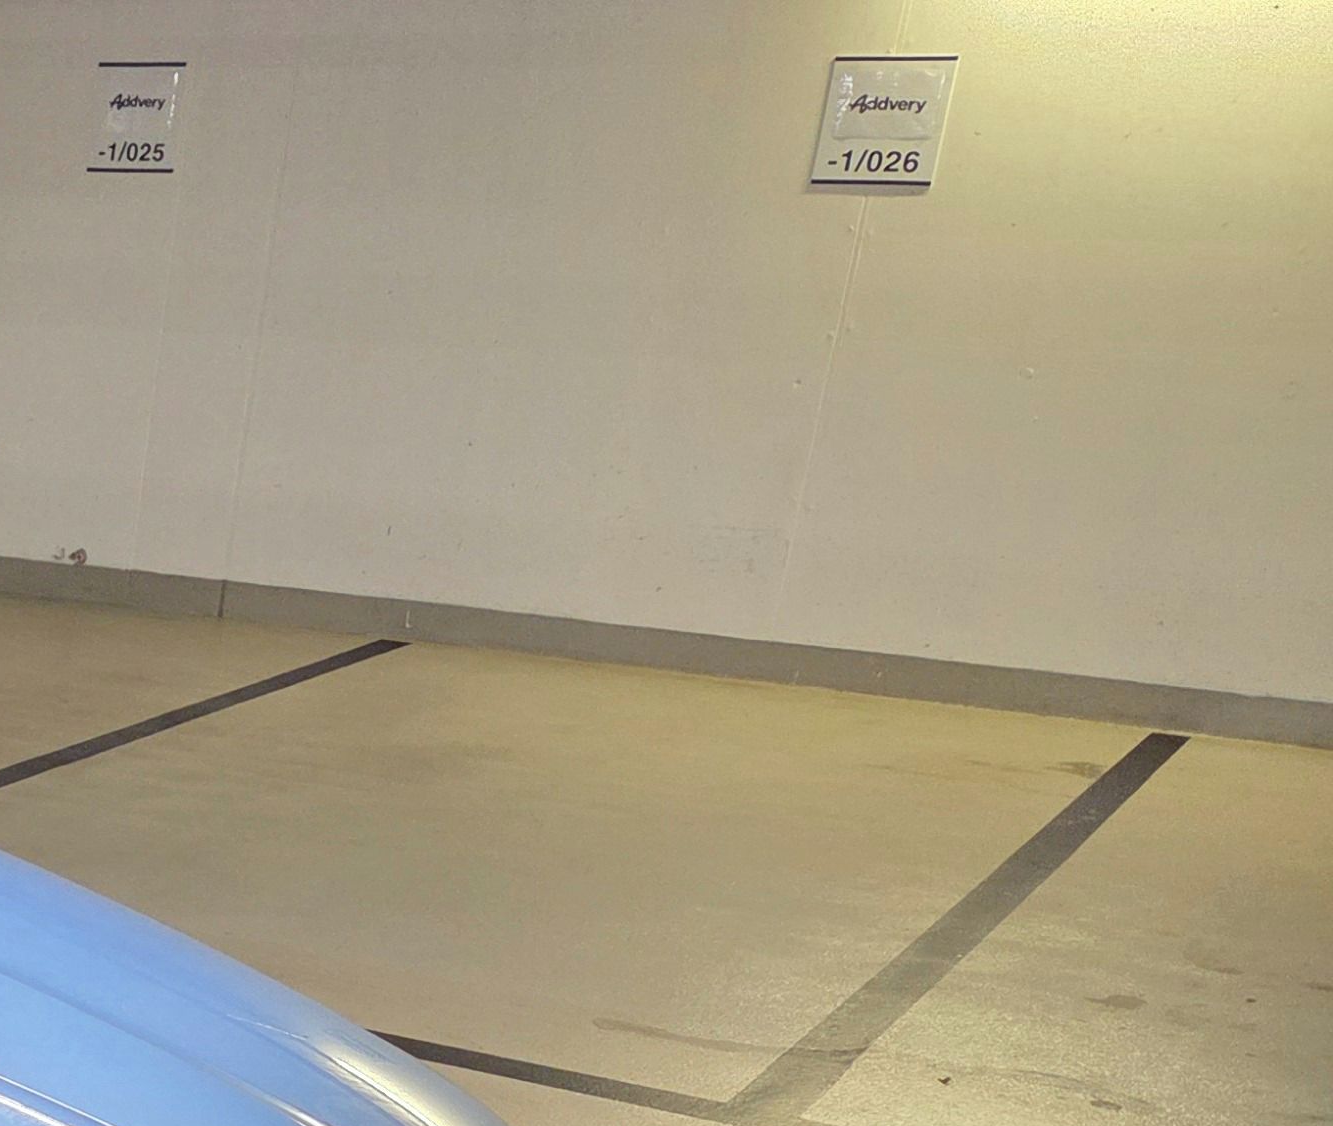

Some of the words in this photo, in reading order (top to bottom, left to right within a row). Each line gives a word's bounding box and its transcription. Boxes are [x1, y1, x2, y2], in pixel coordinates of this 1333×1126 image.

[109, 93, 166, 111] Addvery
[848, 94, 927, 114] Addvery
[98, 141, 165, 162] -1/025
[827, 149, 921, 173] -1/026
